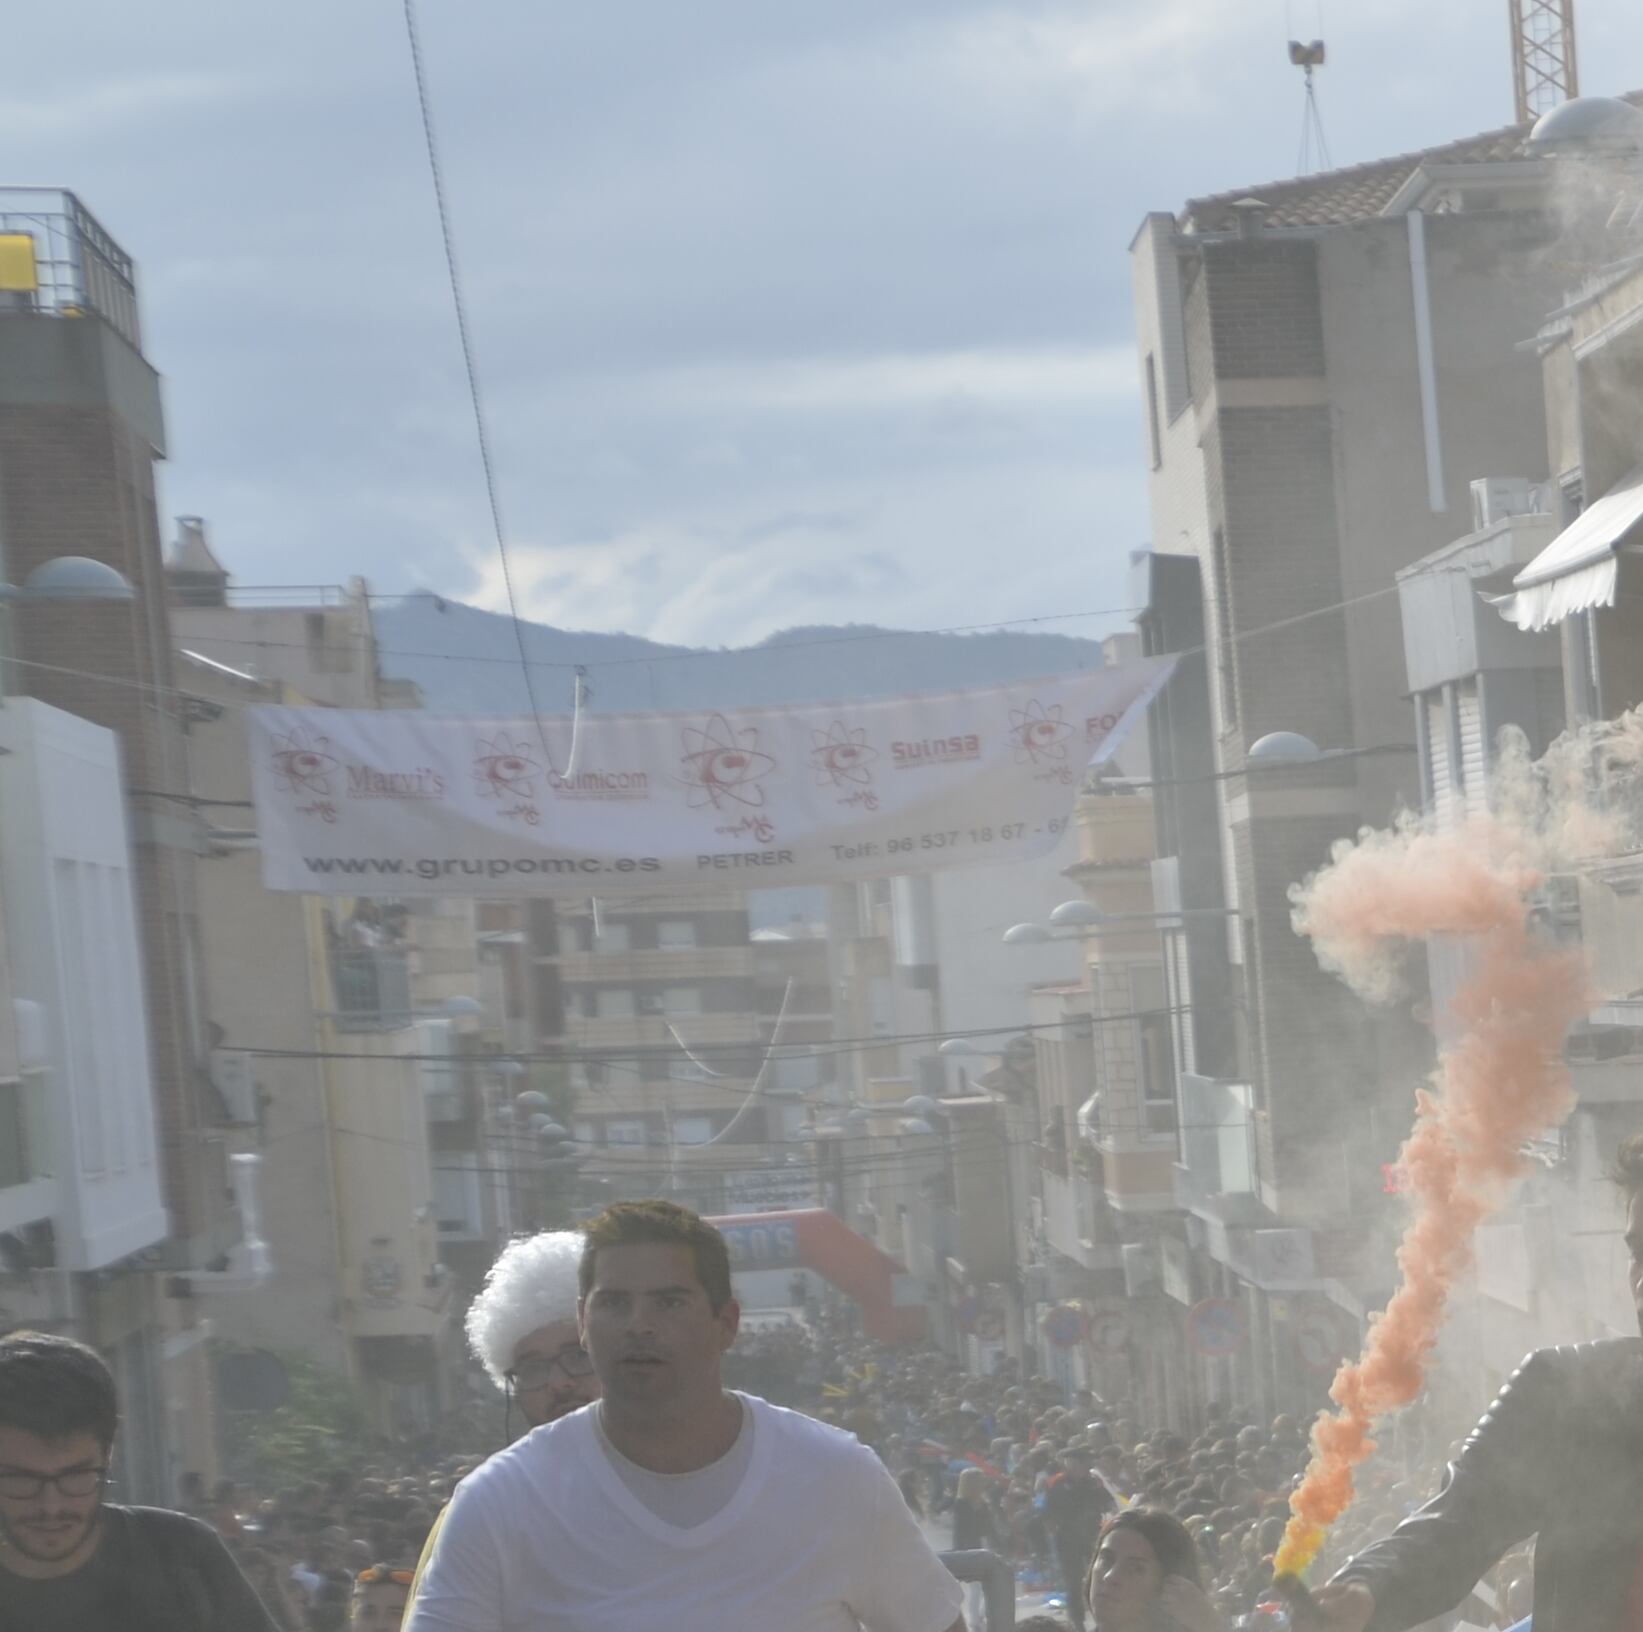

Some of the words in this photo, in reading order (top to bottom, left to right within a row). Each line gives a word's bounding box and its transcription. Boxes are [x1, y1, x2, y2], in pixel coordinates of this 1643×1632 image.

[890, 733, 980, 760] Suinsa
[346, 764, 446, 794] Marvi's
[303, 855, 662, 880] www.grupomc.es
[696, 849, 795, 870] PETRER
[830, 842, 880, 862] Telf:
[886, 836, 913, 855] 96
[920, 829, 960, 850] 537
[968, 826, 994, 844] 18
[1000, 822, 1025, 841] 67
